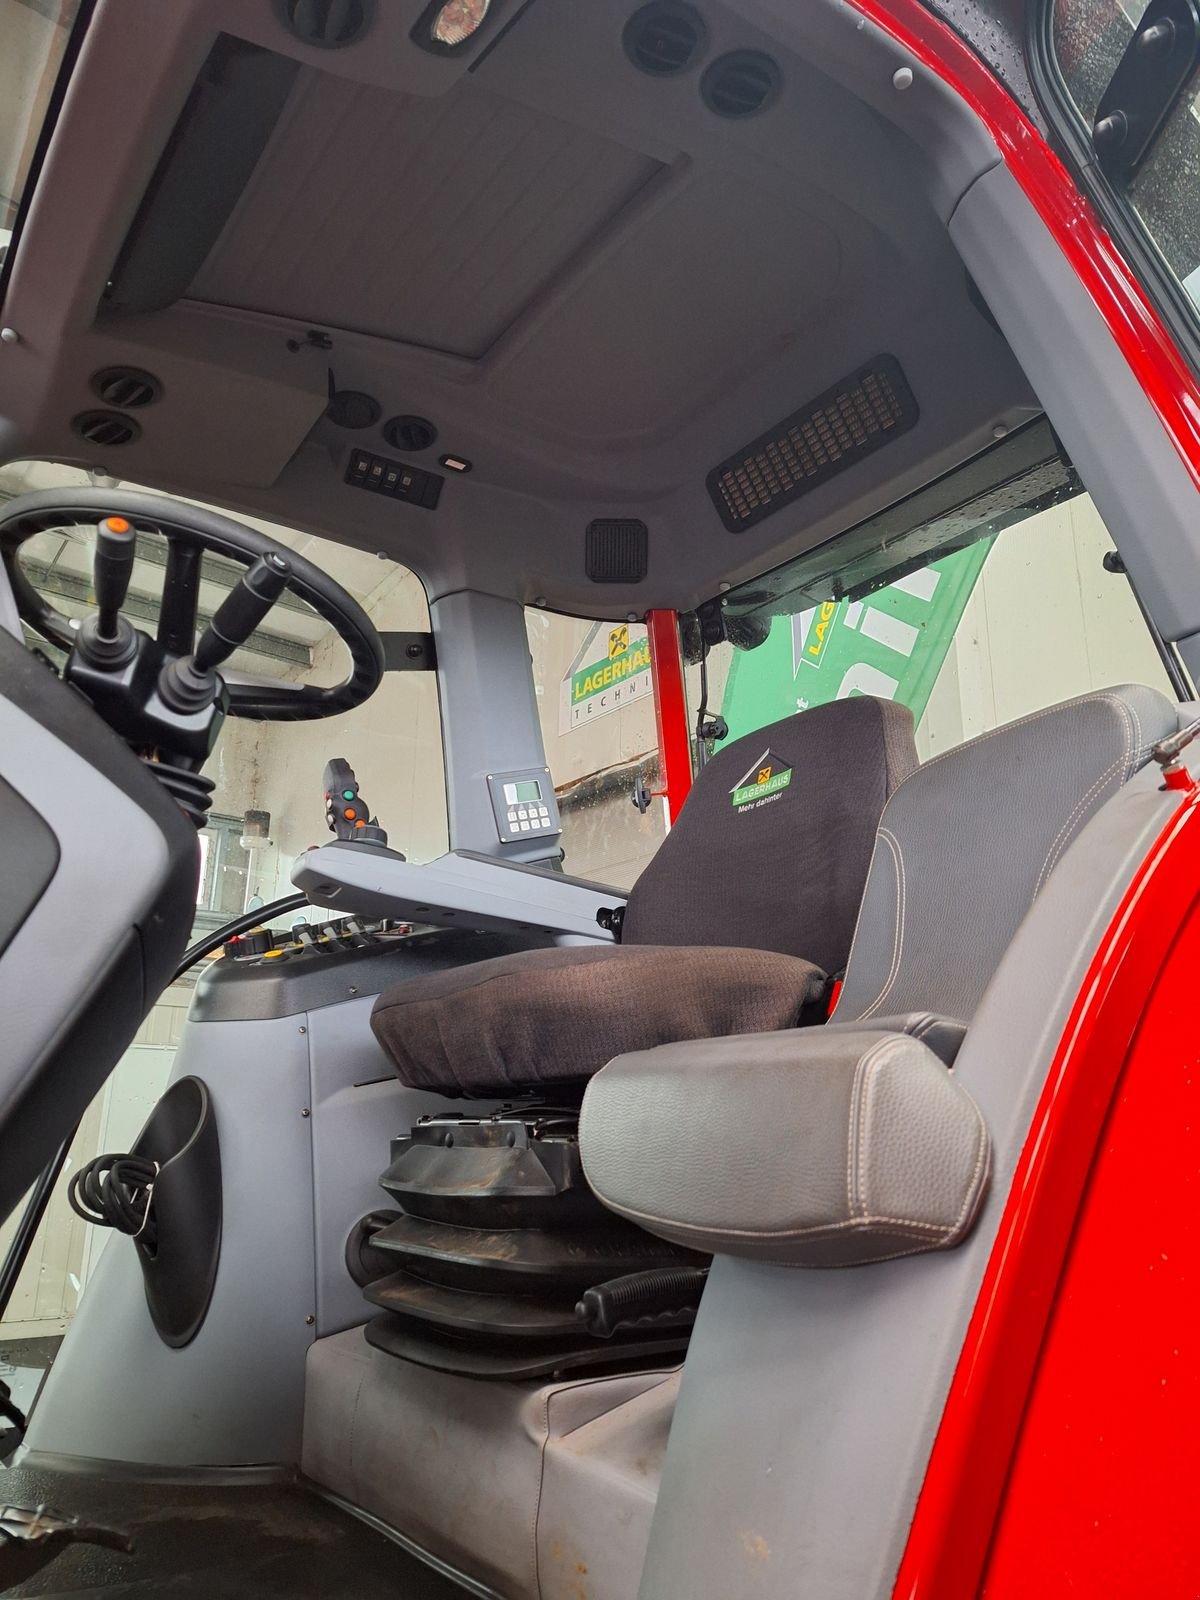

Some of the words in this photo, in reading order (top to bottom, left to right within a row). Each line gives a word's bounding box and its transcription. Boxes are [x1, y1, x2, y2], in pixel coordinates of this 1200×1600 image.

[735, 774, 788, 801] LAGERHAUS
[738, 803, 755, 813] Mehr
[756, 792, 783, 807] dahinter
